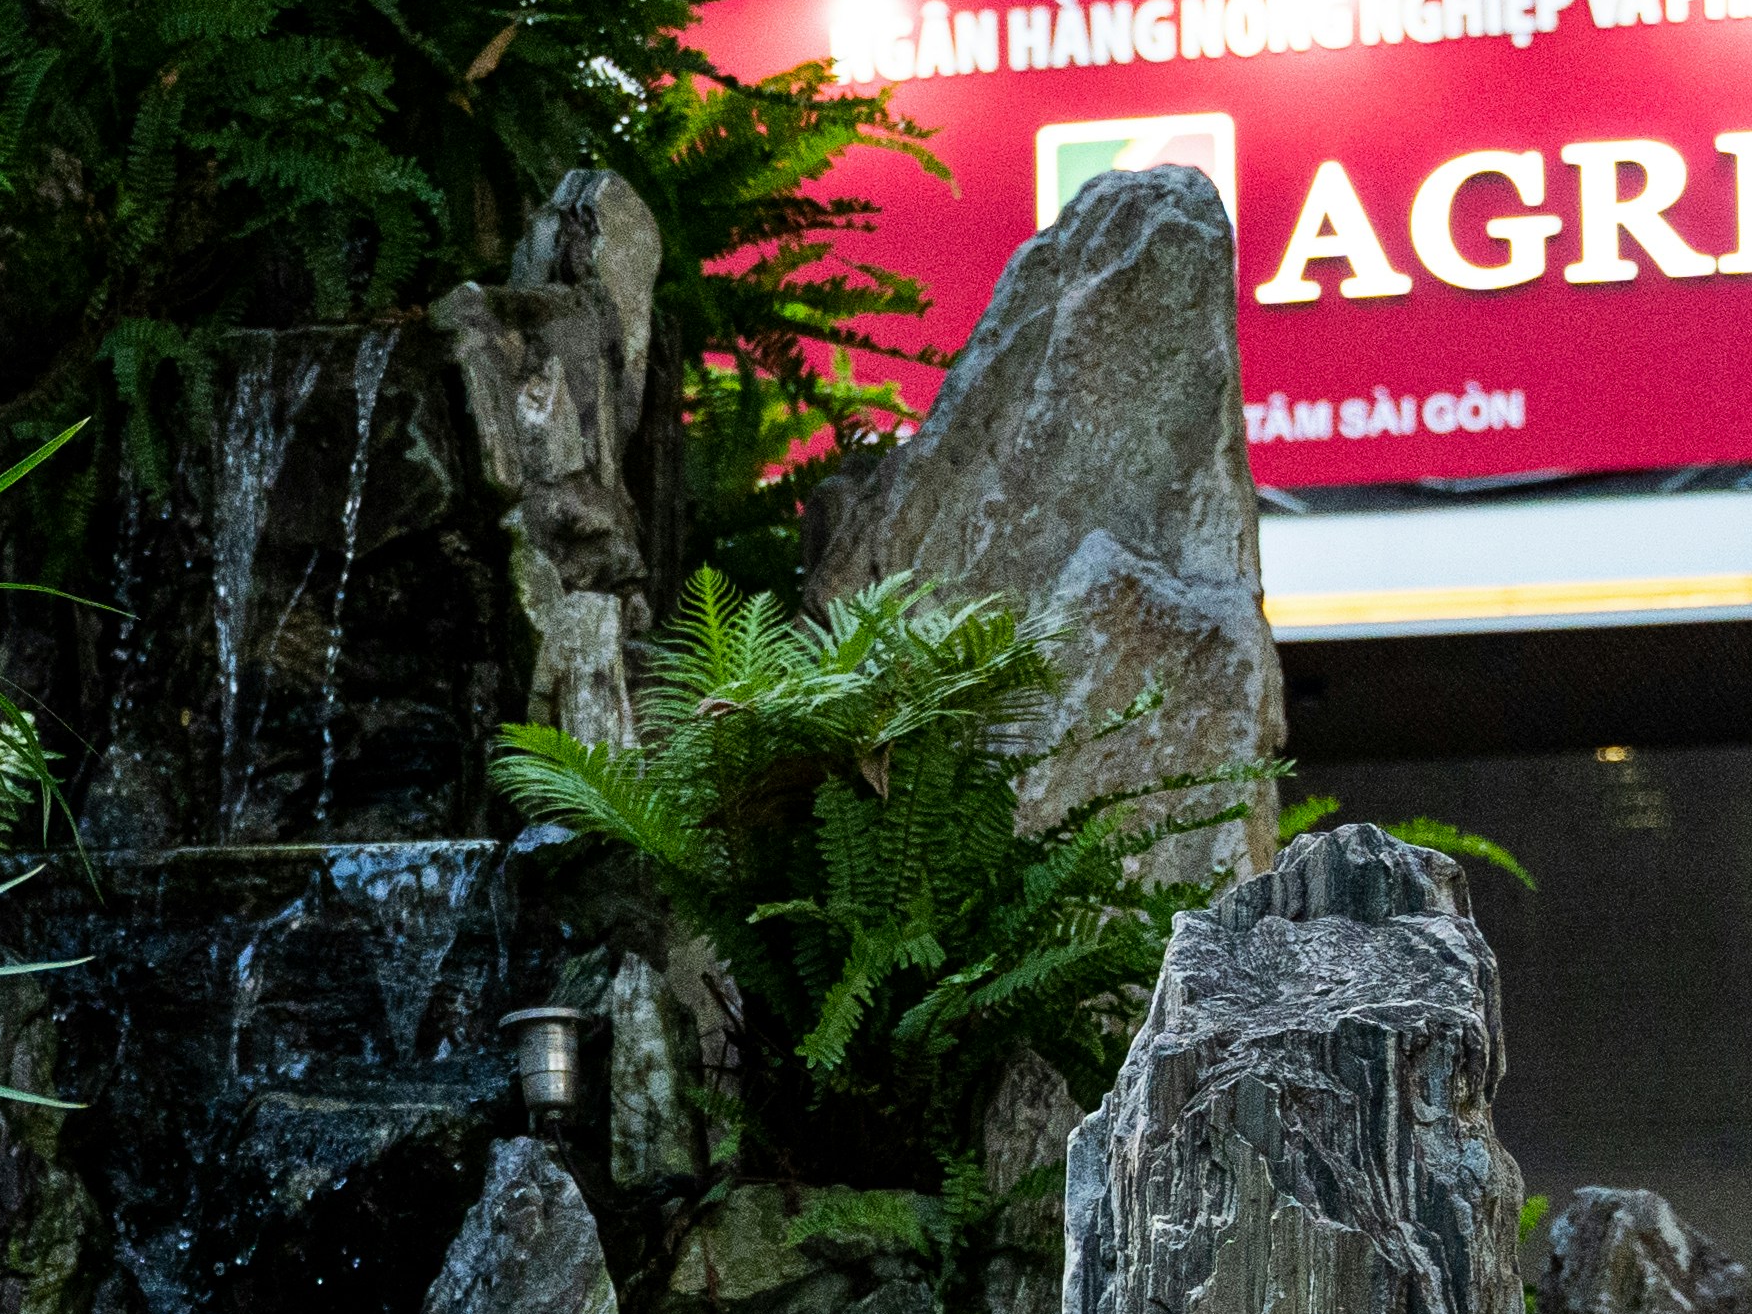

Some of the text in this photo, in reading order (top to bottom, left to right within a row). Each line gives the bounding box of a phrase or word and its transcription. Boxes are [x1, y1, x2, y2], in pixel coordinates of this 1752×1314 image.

[1242, 381, 1526, 446] TÂM SÀI GÒN
